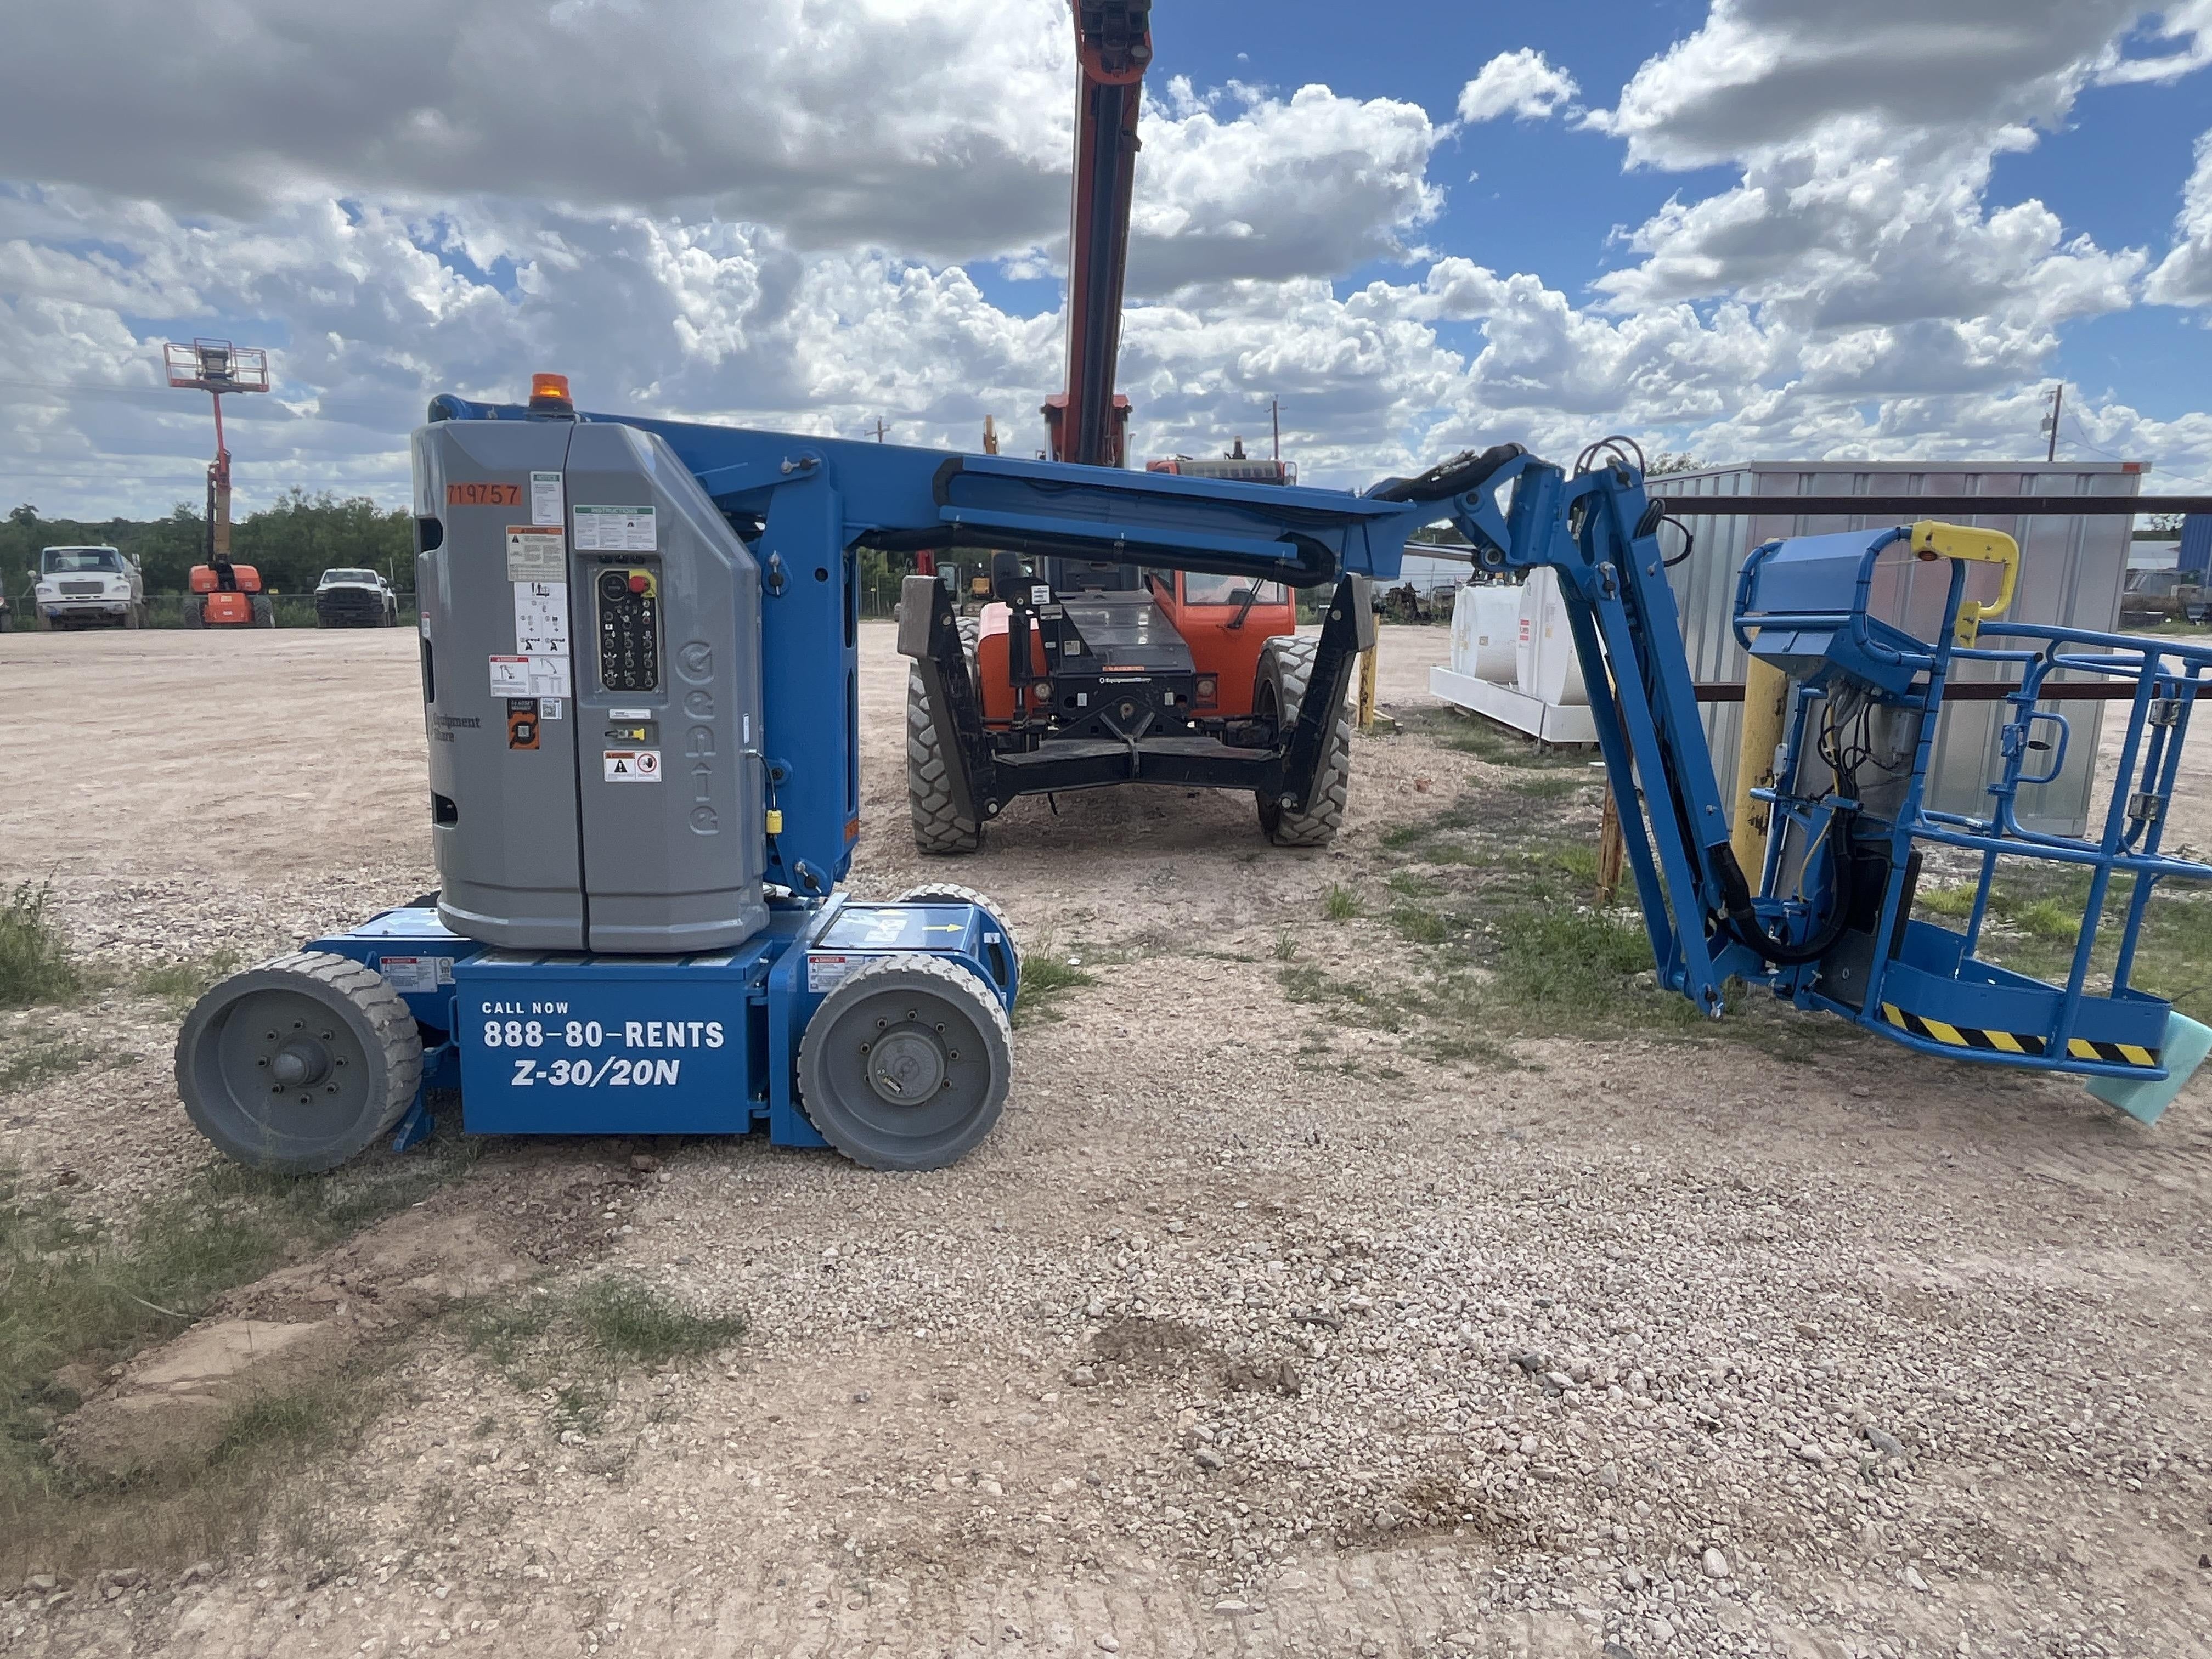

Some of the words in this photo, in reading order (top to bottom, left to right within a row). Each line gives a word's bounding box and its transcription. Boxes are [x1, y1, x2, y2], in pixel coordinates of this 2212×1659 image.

[447, 484, 518, 505] 719757
[675, 641, 720, 836] Genie
[482, 1002, 524, 1014] CALL
[532, 1002, 569, 1014] NOW
[484, 1020, 724, 1048] 888-80-RENTS
[511, 1056, 680, 1087] Z-30/20N
